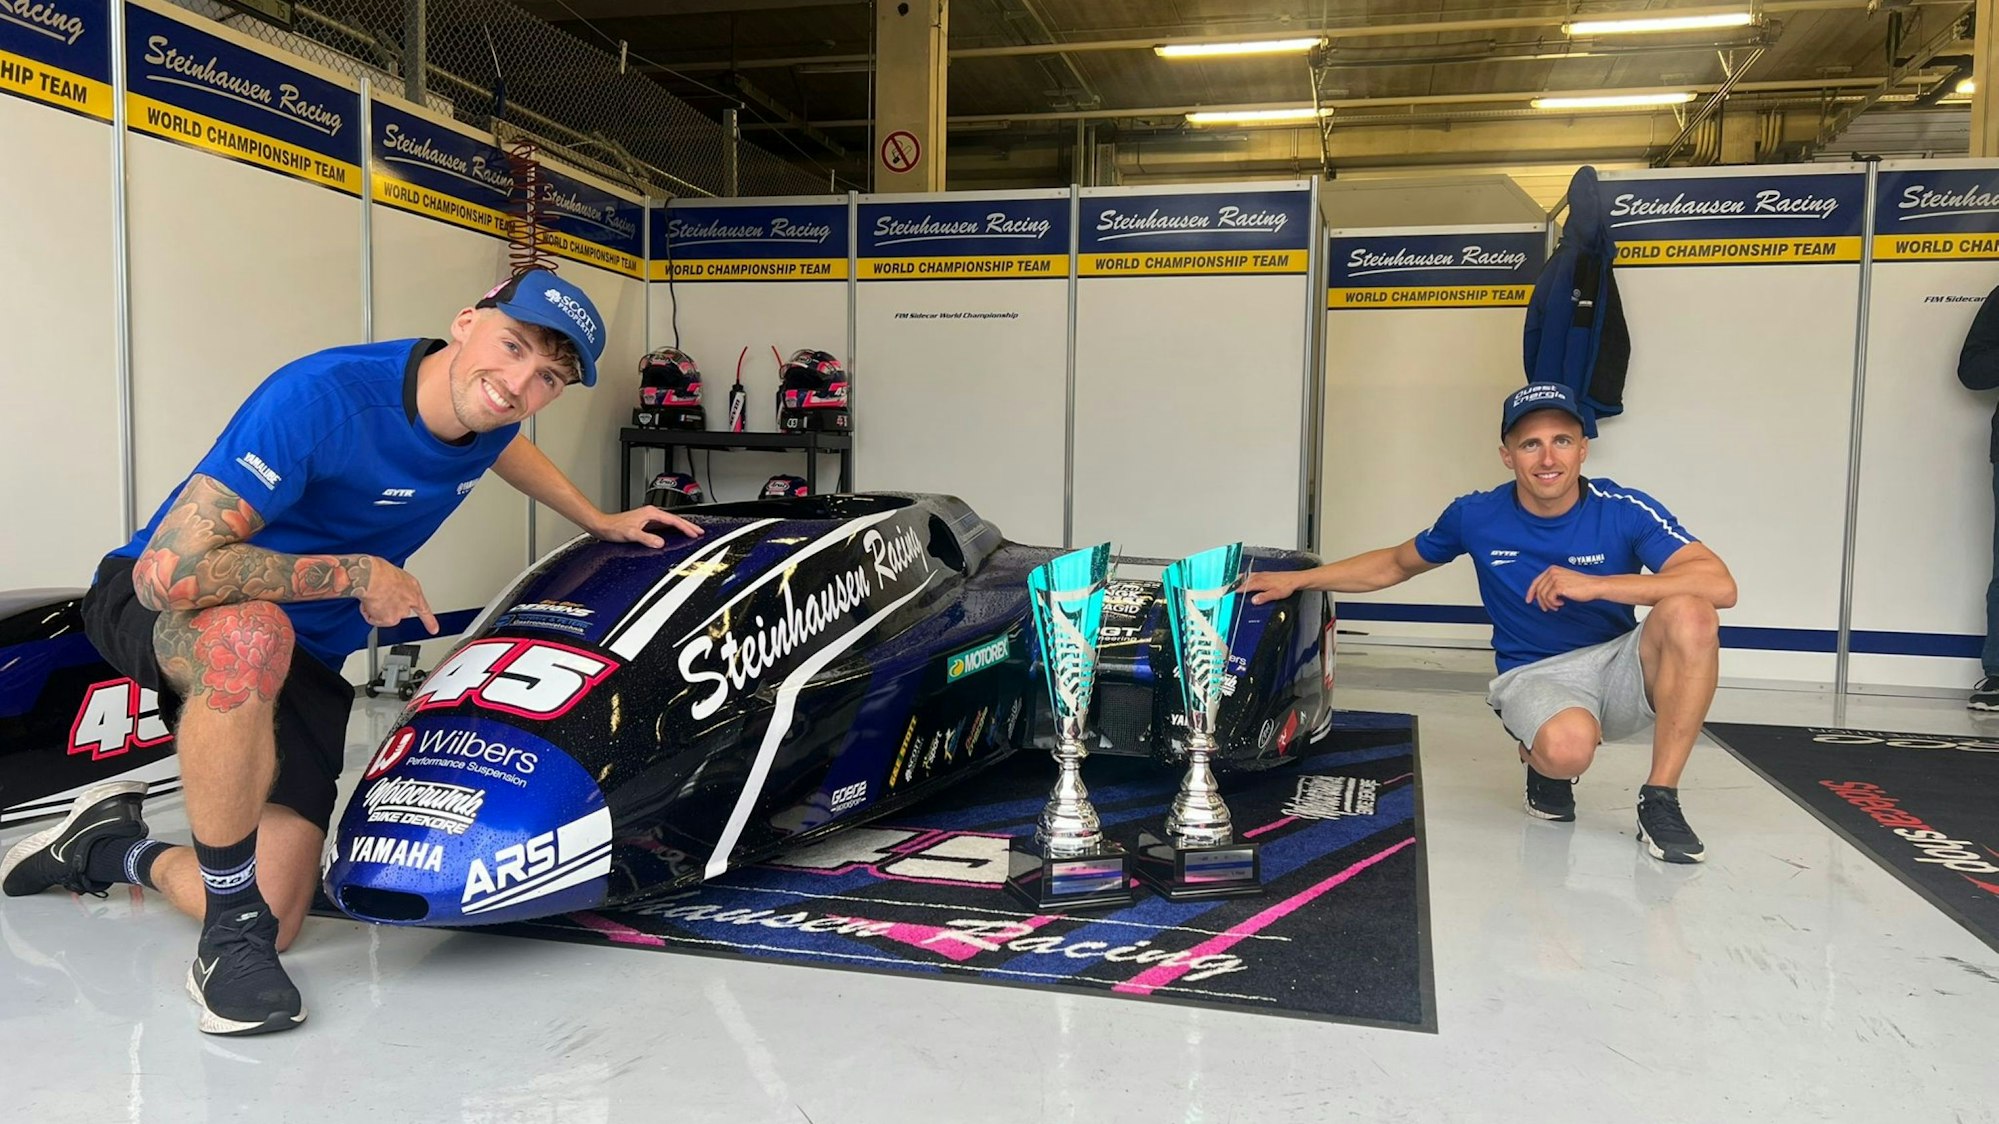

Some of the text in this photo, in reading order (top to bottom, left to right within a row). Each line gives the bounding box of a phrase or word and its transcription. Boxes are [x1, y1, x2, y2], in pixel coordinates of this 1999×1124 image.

[0, 0, 85, 45] acing
[39, 72, 87, 104] TEAM
[145, 35, 343, 136] Steinhausen Racing
[147, 107, 345, 183] WORLD CHAMPIONSHIP TEAM
[383, 124, 514, 196] Steinhausen Racing
[384, 182, 516, 234] WORLD CHAMPIONSHIP TEAM
[542, 183, 636, 240] Steinhausen Racing
[1096, 206, 1289, 232] Steinhausen Racing
[1610, 190, 1839, 219] Steinhausen Racing
[665, 218, 831, 244] Steinhausen Racing
[874, 213, 1051, 239] Steinhausen Racing
[543, 232, 637, 271] WORLD CHAMPIONSHIP TEAM
[1095, 255, 1289, 270] WORLD CHAMPIONSHIP TEAM
[1347, 246, 1527, 270] Steinhausen Racing
[1616, 243, 1836, 258] ORLD CHAMPIONSHIP TEAM
[1896, 240, 1953, 254] WORLD
[665, 263, 831, 275] WORLD CHAMPIONSHIP TEAM
[873, 260, 1051, 274] WORLD CHAMPIONSHIP TEAM
[1345, 289, 1526, 302] WORLD CHAMPIONSHIP TEAM
[561, 296, 597, 332] SCOTT
[243, 452, 281, 484] YAMALUBE
[382, 489, 416, 497] GYTR
[1577, 554, 1605, 563] YAMAHA
[678, 526, 929, 720] Steinhausen Racing
[1102, 604, 1140, 614] AGID
[964, 640, 1009, 673] MOTOREX
[415, 640, 612, 716] 45
[418, 730, 539, 775] Wilbers
[406, 757, 527, 788] Performance Suspension
[367, 812, 469, 835] BIKE DEKORE
[349, 837, 444, 872] YAMAHA
[461, 831, 555, 902] ARS
[920, 917, 1249, 982] Racing
